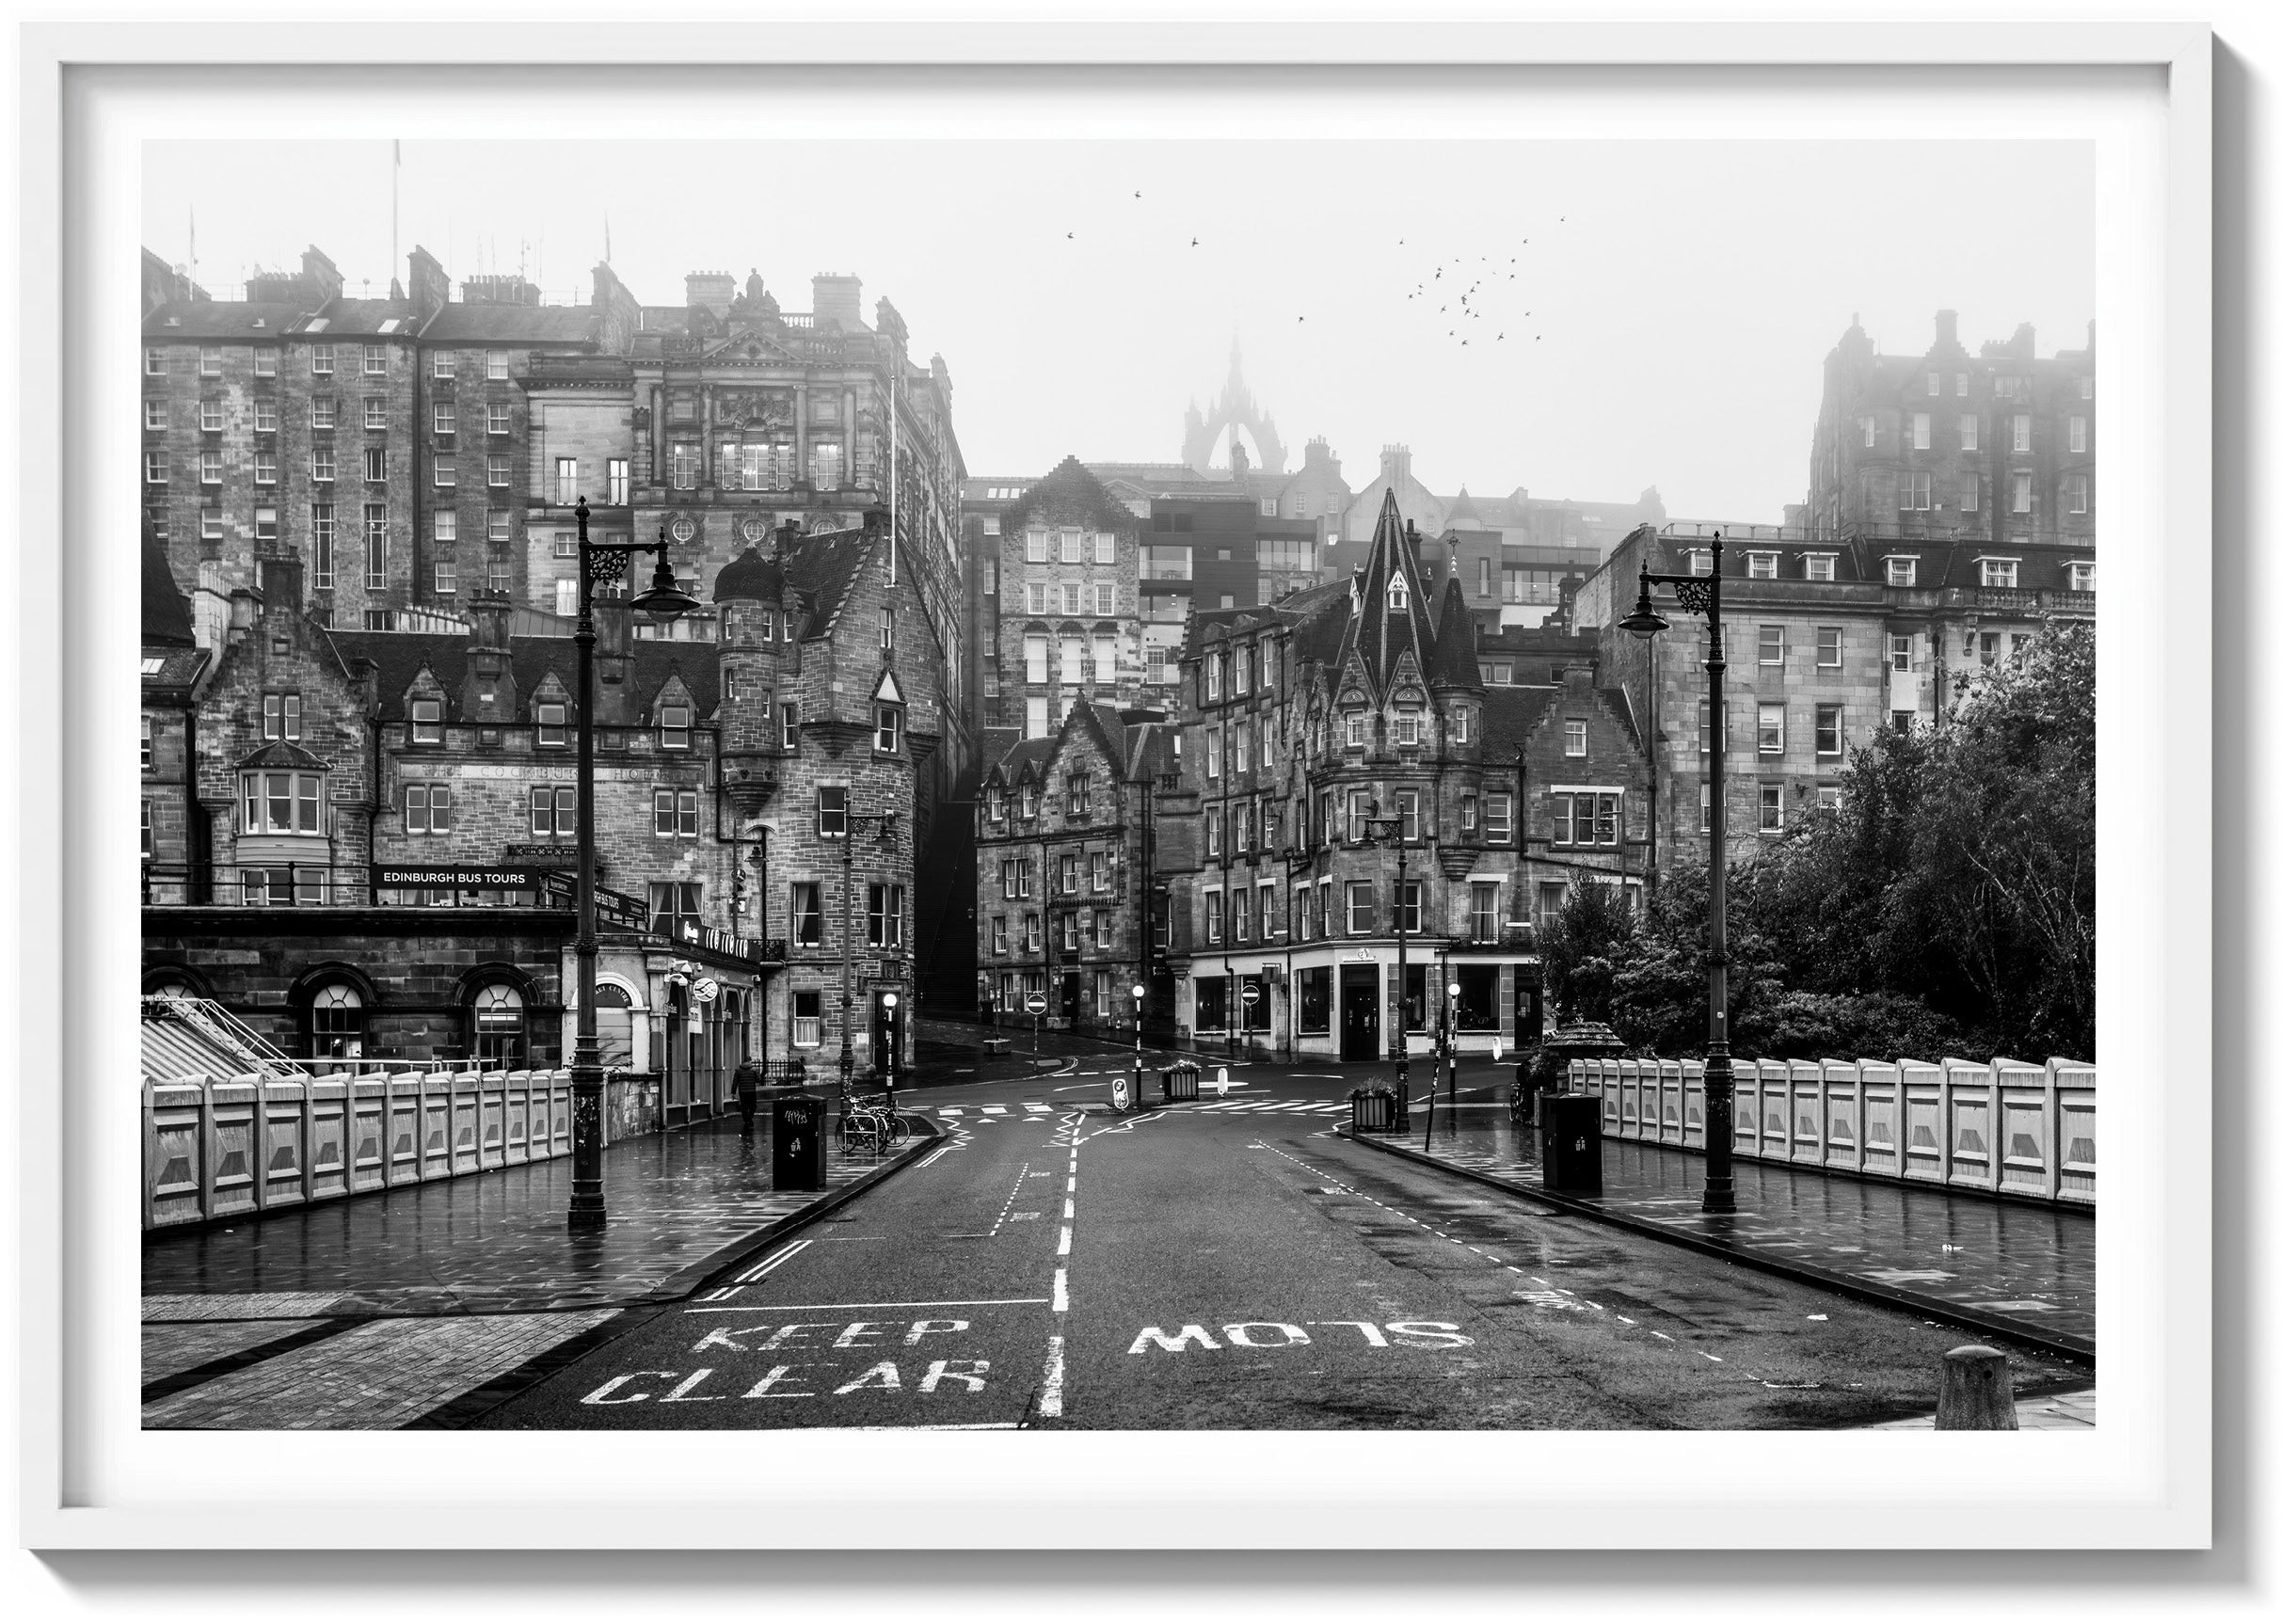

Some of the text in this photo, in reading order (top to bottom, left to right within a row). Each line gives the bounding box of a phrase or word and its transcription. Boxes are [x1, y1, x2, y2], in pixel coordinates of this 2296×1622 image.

[383, 872, 526, 883] EDINBURGH BUS TOURS
[690, 1319, 970, 1353] KEEP
[1127, 1321, 1476, 1355] SLOW
[580, 1360, 991, 1405] CLEAR
